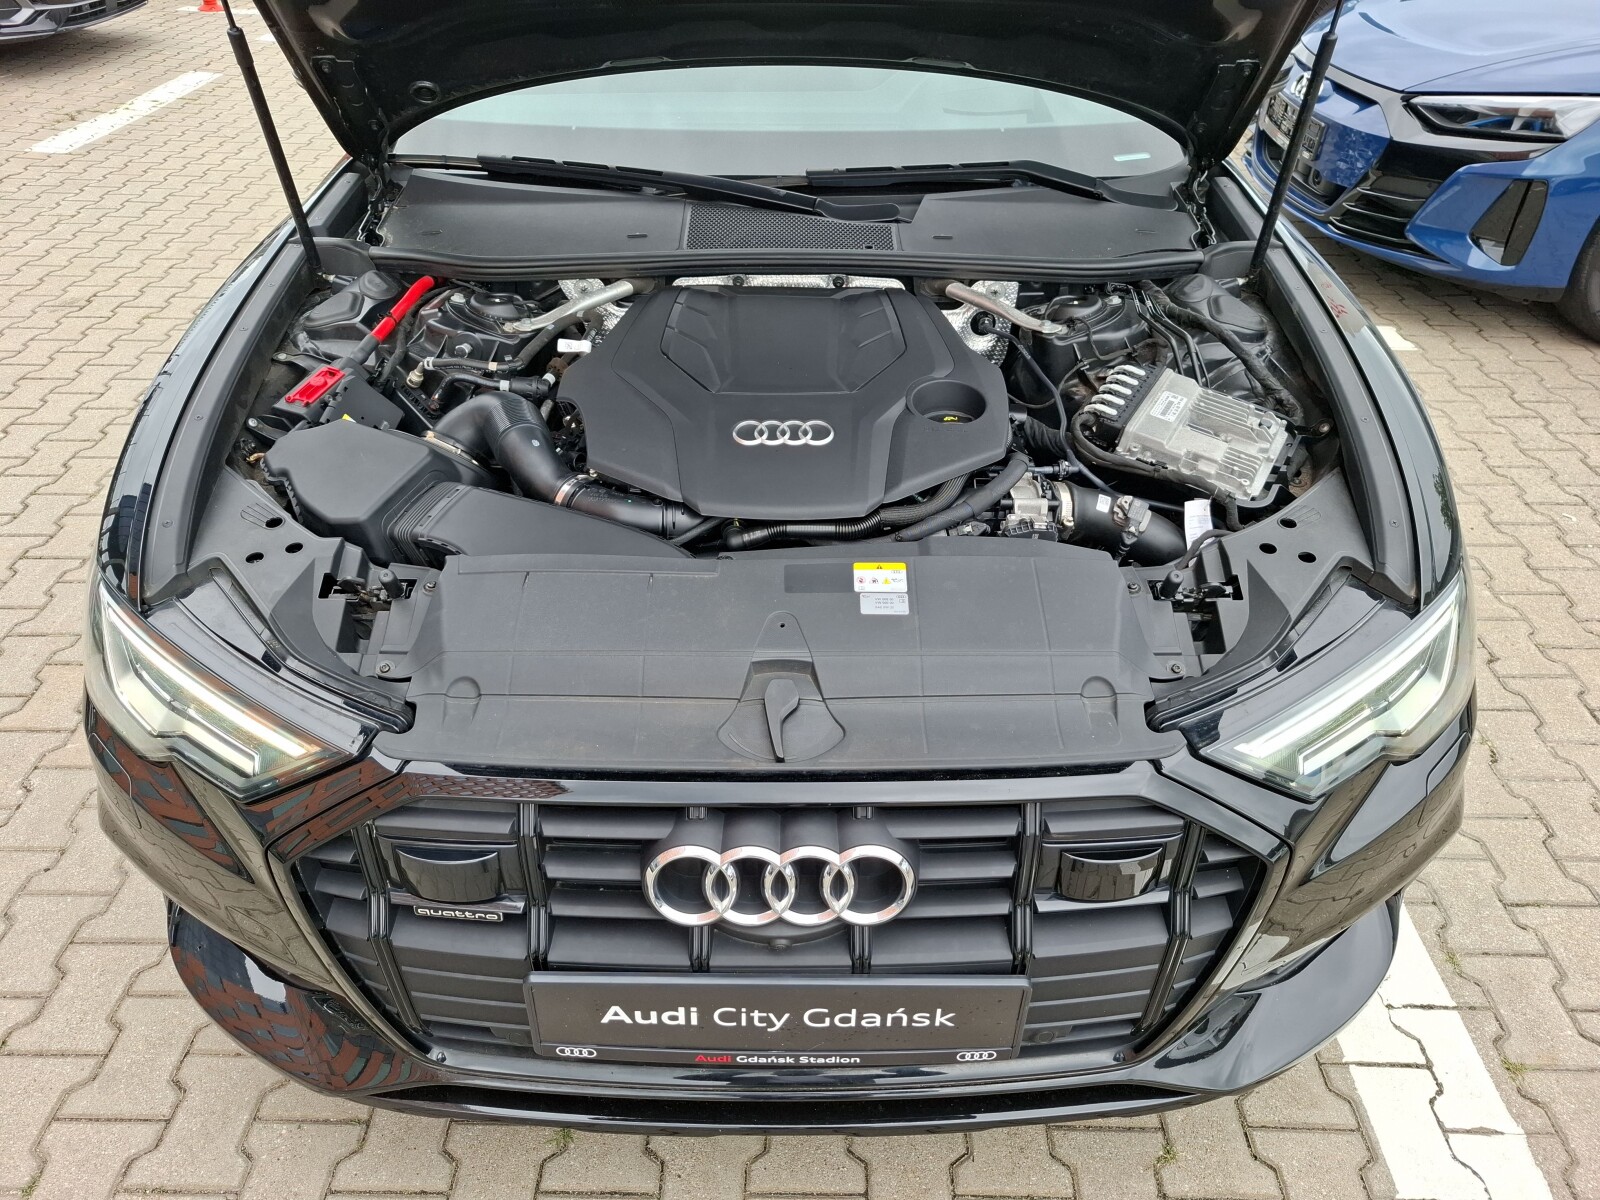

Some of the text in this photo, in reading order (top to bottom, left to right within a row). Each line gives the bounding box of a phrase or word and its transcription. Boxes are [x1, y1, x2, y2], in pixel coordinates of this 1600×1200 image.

[417, 908, 498, 920] quattro
[600, 1005, 956, 1032] Audi City Gdańsk
[695, 1054, 861, 1065] Audi Gdańsk Stadion
